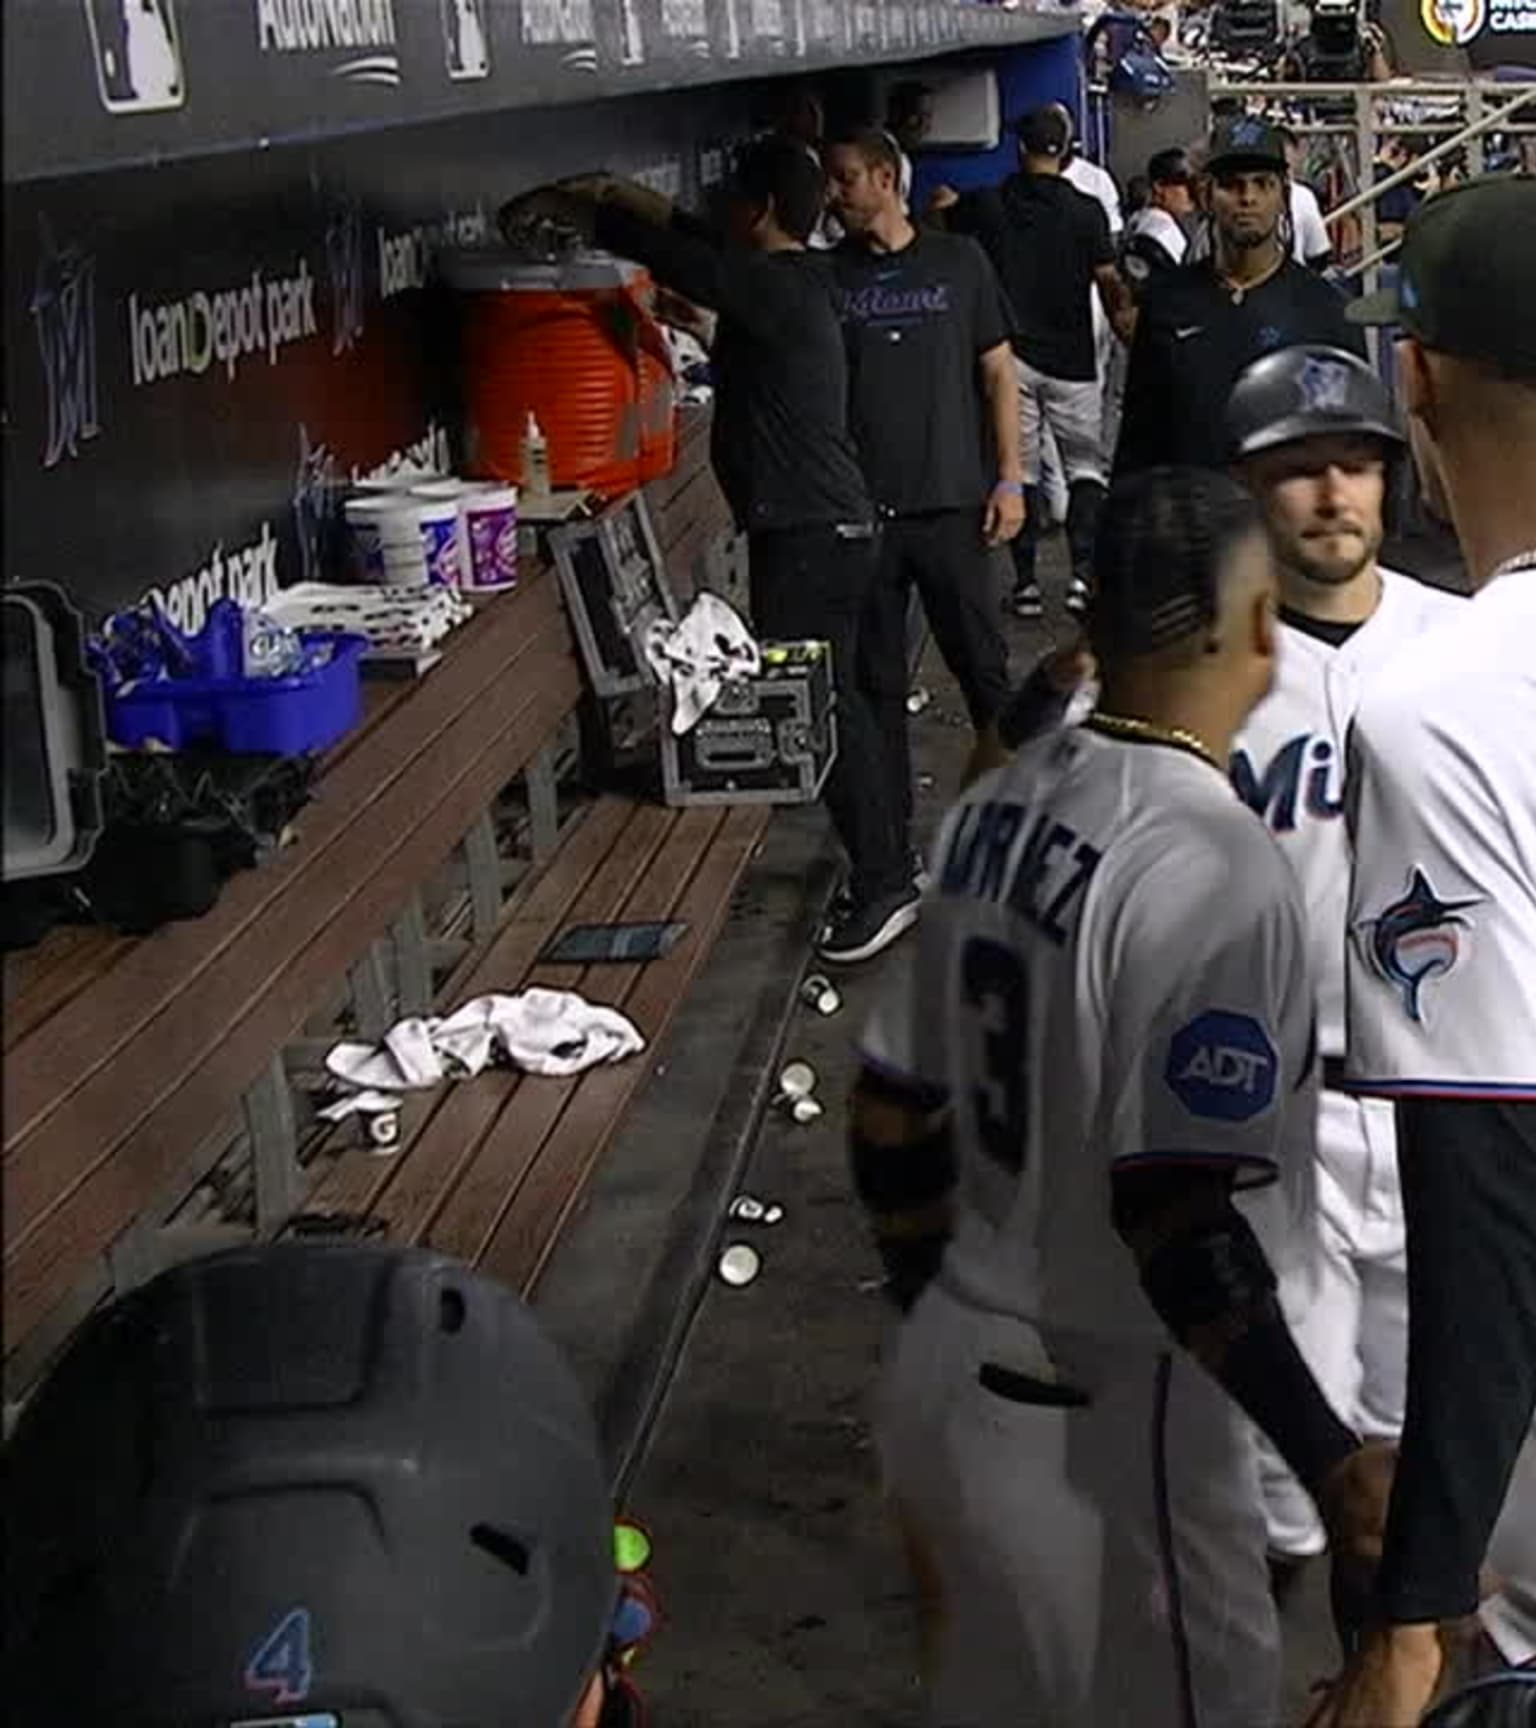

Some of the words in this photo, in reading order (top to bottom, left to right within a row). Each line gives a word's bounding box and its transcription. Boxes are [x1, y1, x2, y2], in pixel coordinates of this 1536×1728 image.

[129, 270, 263, 386] loanDepot
[266, 258, 317, 366] park
[1179, 1045, 1268, 1092] ADT
[244, 1606, 311, 1702] 4
